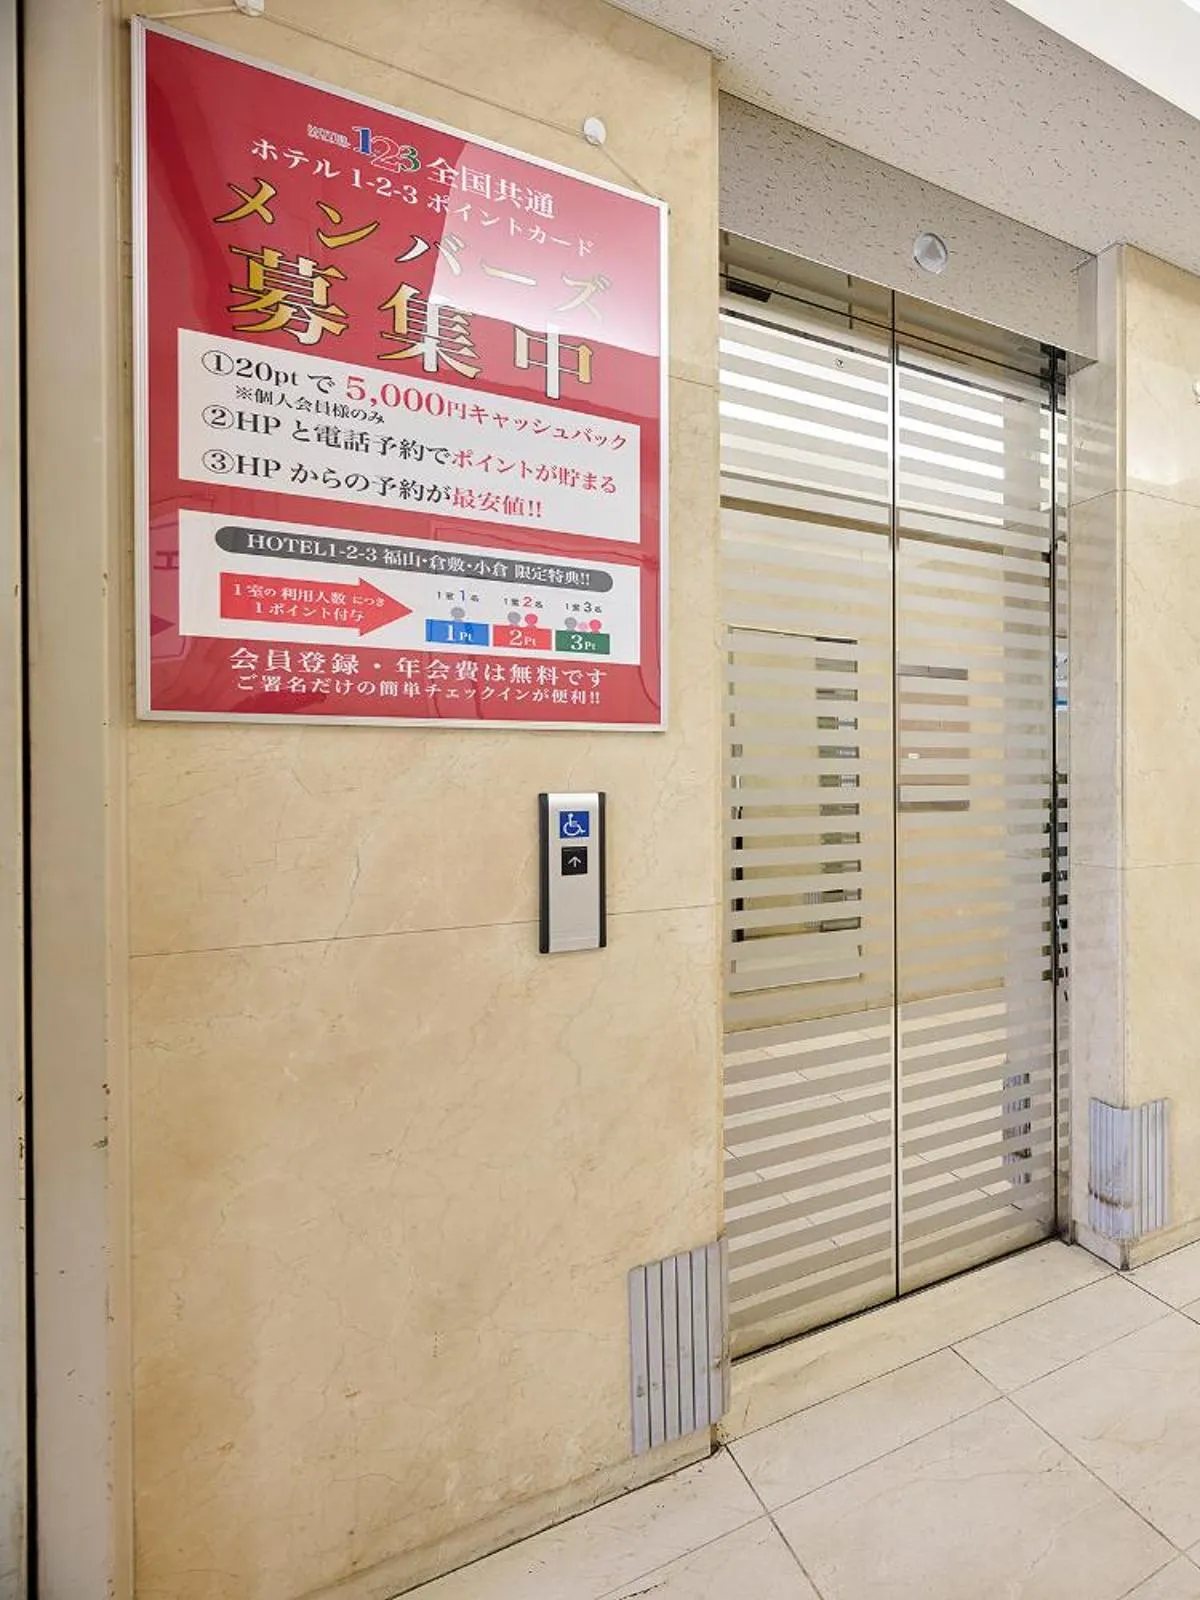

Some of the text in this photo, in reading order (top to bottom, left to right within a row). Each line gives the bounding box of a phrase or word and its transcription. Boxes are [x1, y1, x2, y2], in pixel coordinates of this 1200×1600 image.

[252, 139, 594, 257] ホテル 1-2-3 ポイントカード
[426, 157, 555, 219] 全国共通
[212, 176, 612, 321] メンバーズ
[228, 244, 595, 402] 募集中
[247, 533, 377, 562] HOTEL1-2-3
